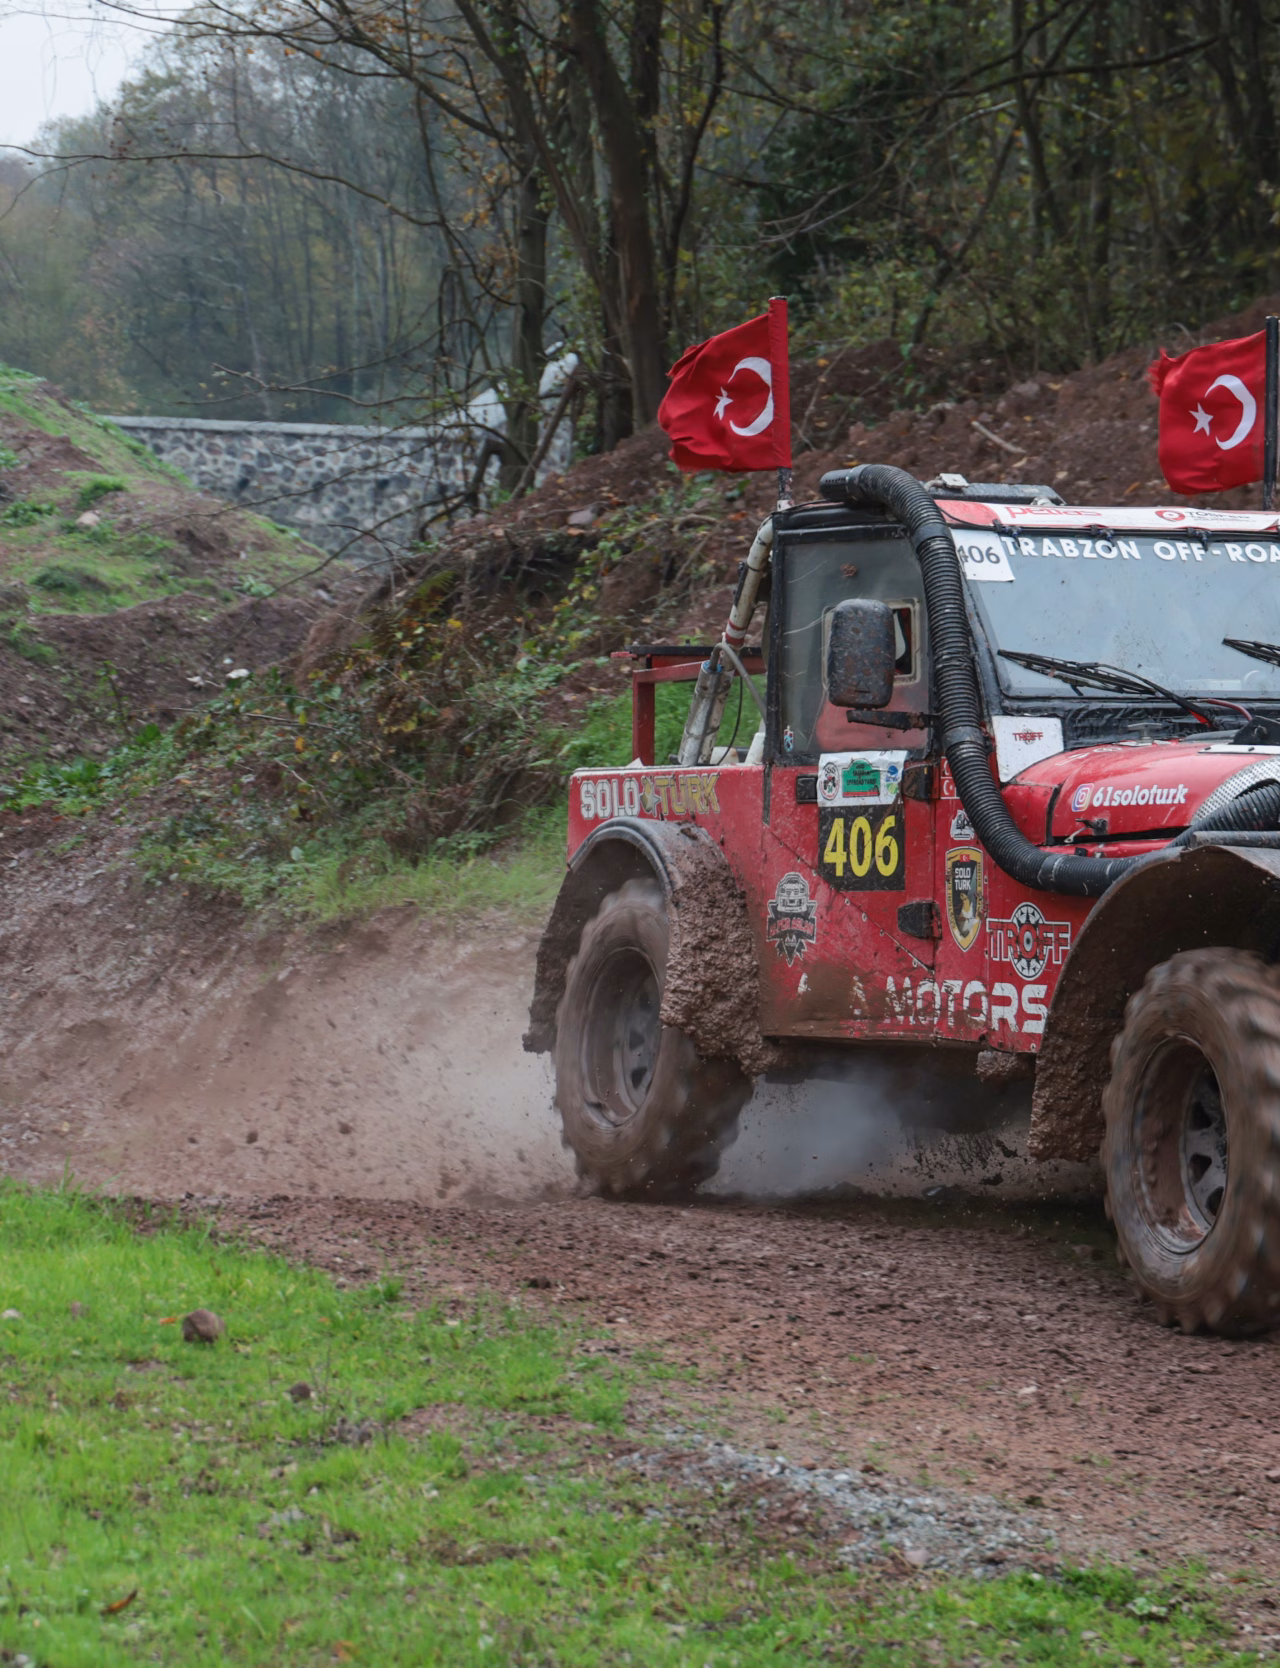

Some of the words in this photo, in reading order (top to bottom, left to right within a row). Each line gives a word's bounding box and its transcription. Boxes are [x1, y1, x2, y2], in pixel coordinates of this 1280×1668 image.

[956, 545, 1001, 565] 406
[1000, 536, 1142, 561] TRABZON
[580, 777, 640, 820] SOLO
[1092, 783, 1189, 809] 61soloturk
[823, 814, 899, 878] 406
[954, 867, 971, 879] SOLO
[986, 919, 1071, 964] TROFF
[883, 974, 1049, 1034] MOTORS
